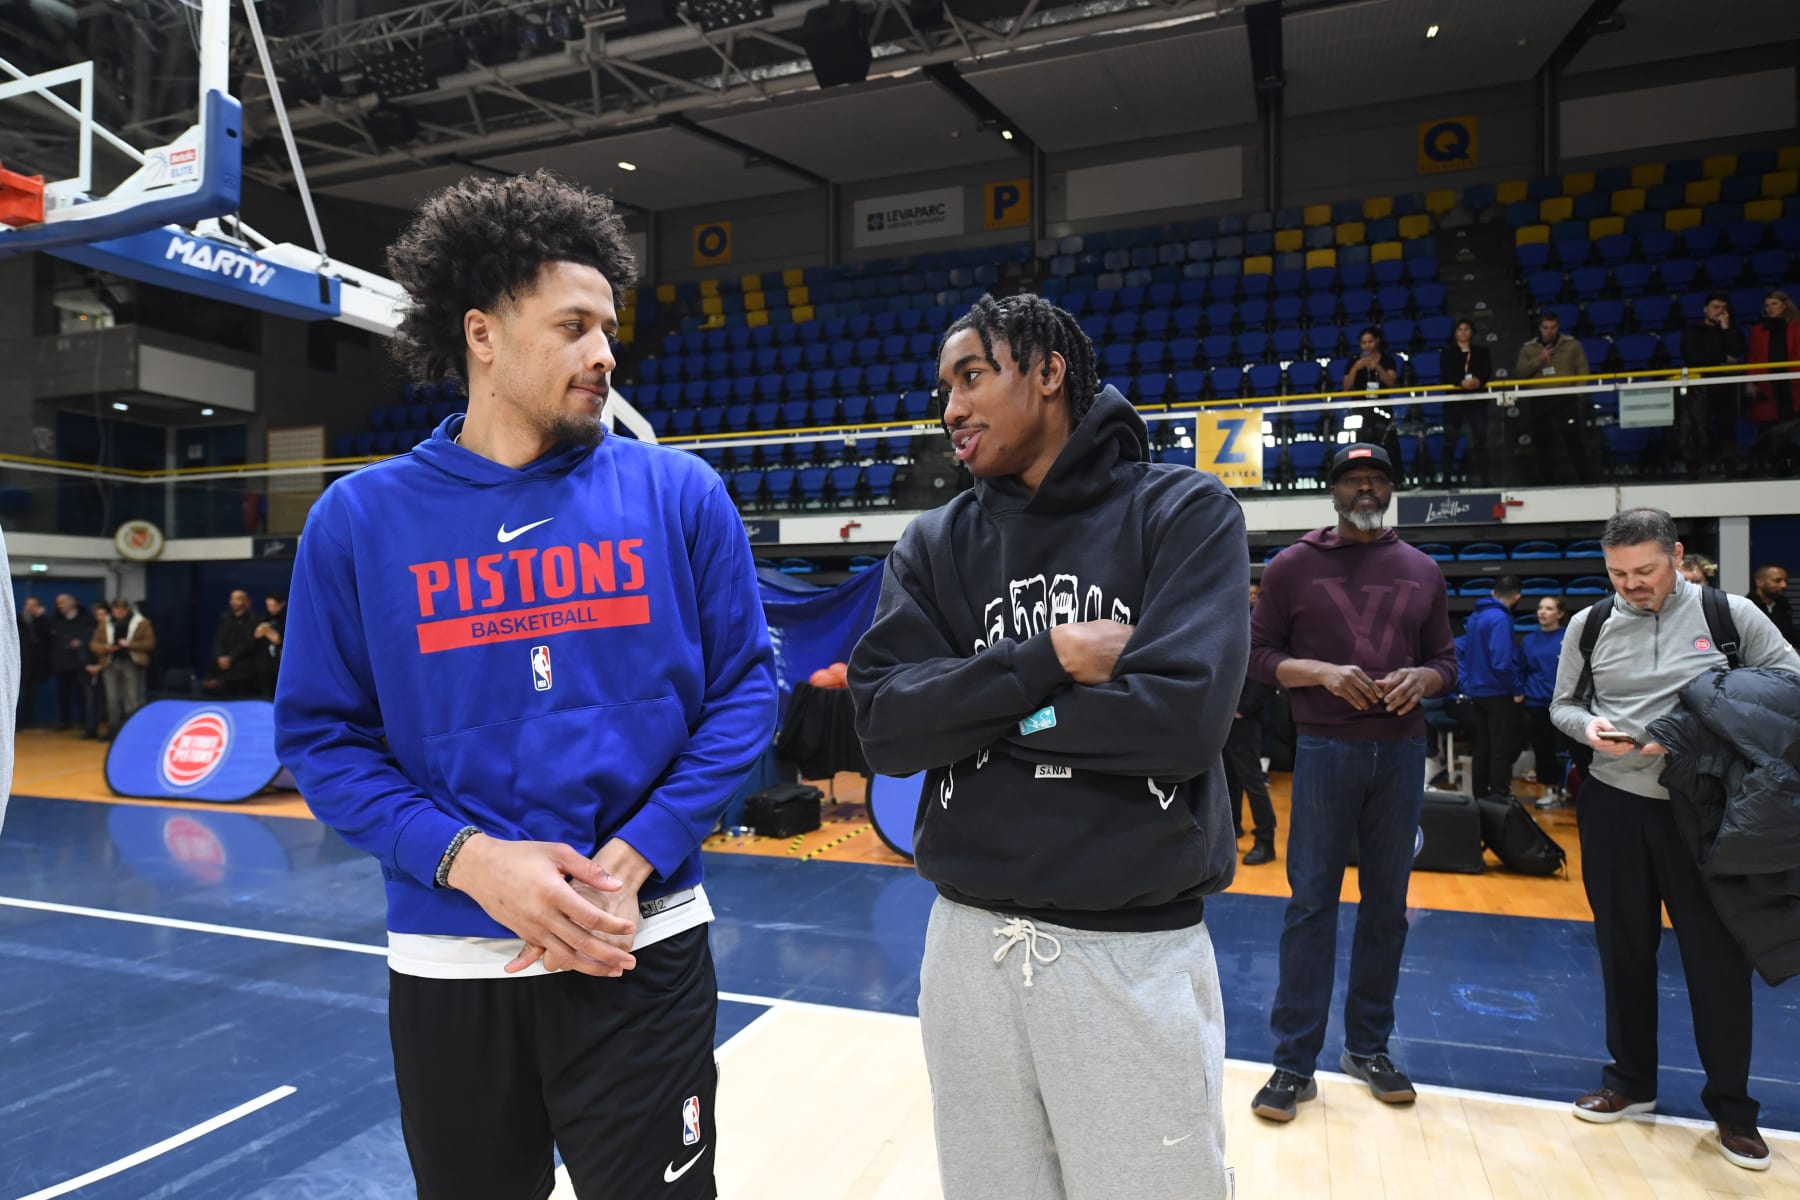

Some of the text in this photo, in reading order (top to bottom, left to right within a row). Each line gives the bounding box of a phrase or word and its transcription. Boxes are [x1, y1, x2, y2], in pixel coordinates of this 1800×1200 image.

[1424, 122, 1471, 161] Q
[886, 203, 946, 222] LEVAPARC
[994, 185, 1020, 220] P
[165, 236, 269, 284] MARTY
[698, 226, 727, 257] O
[1213, 418, 1247, 464] Z
[408, 538, 645, 617] PISTONS
[471, 607, 598, 638] BASKETBALL
